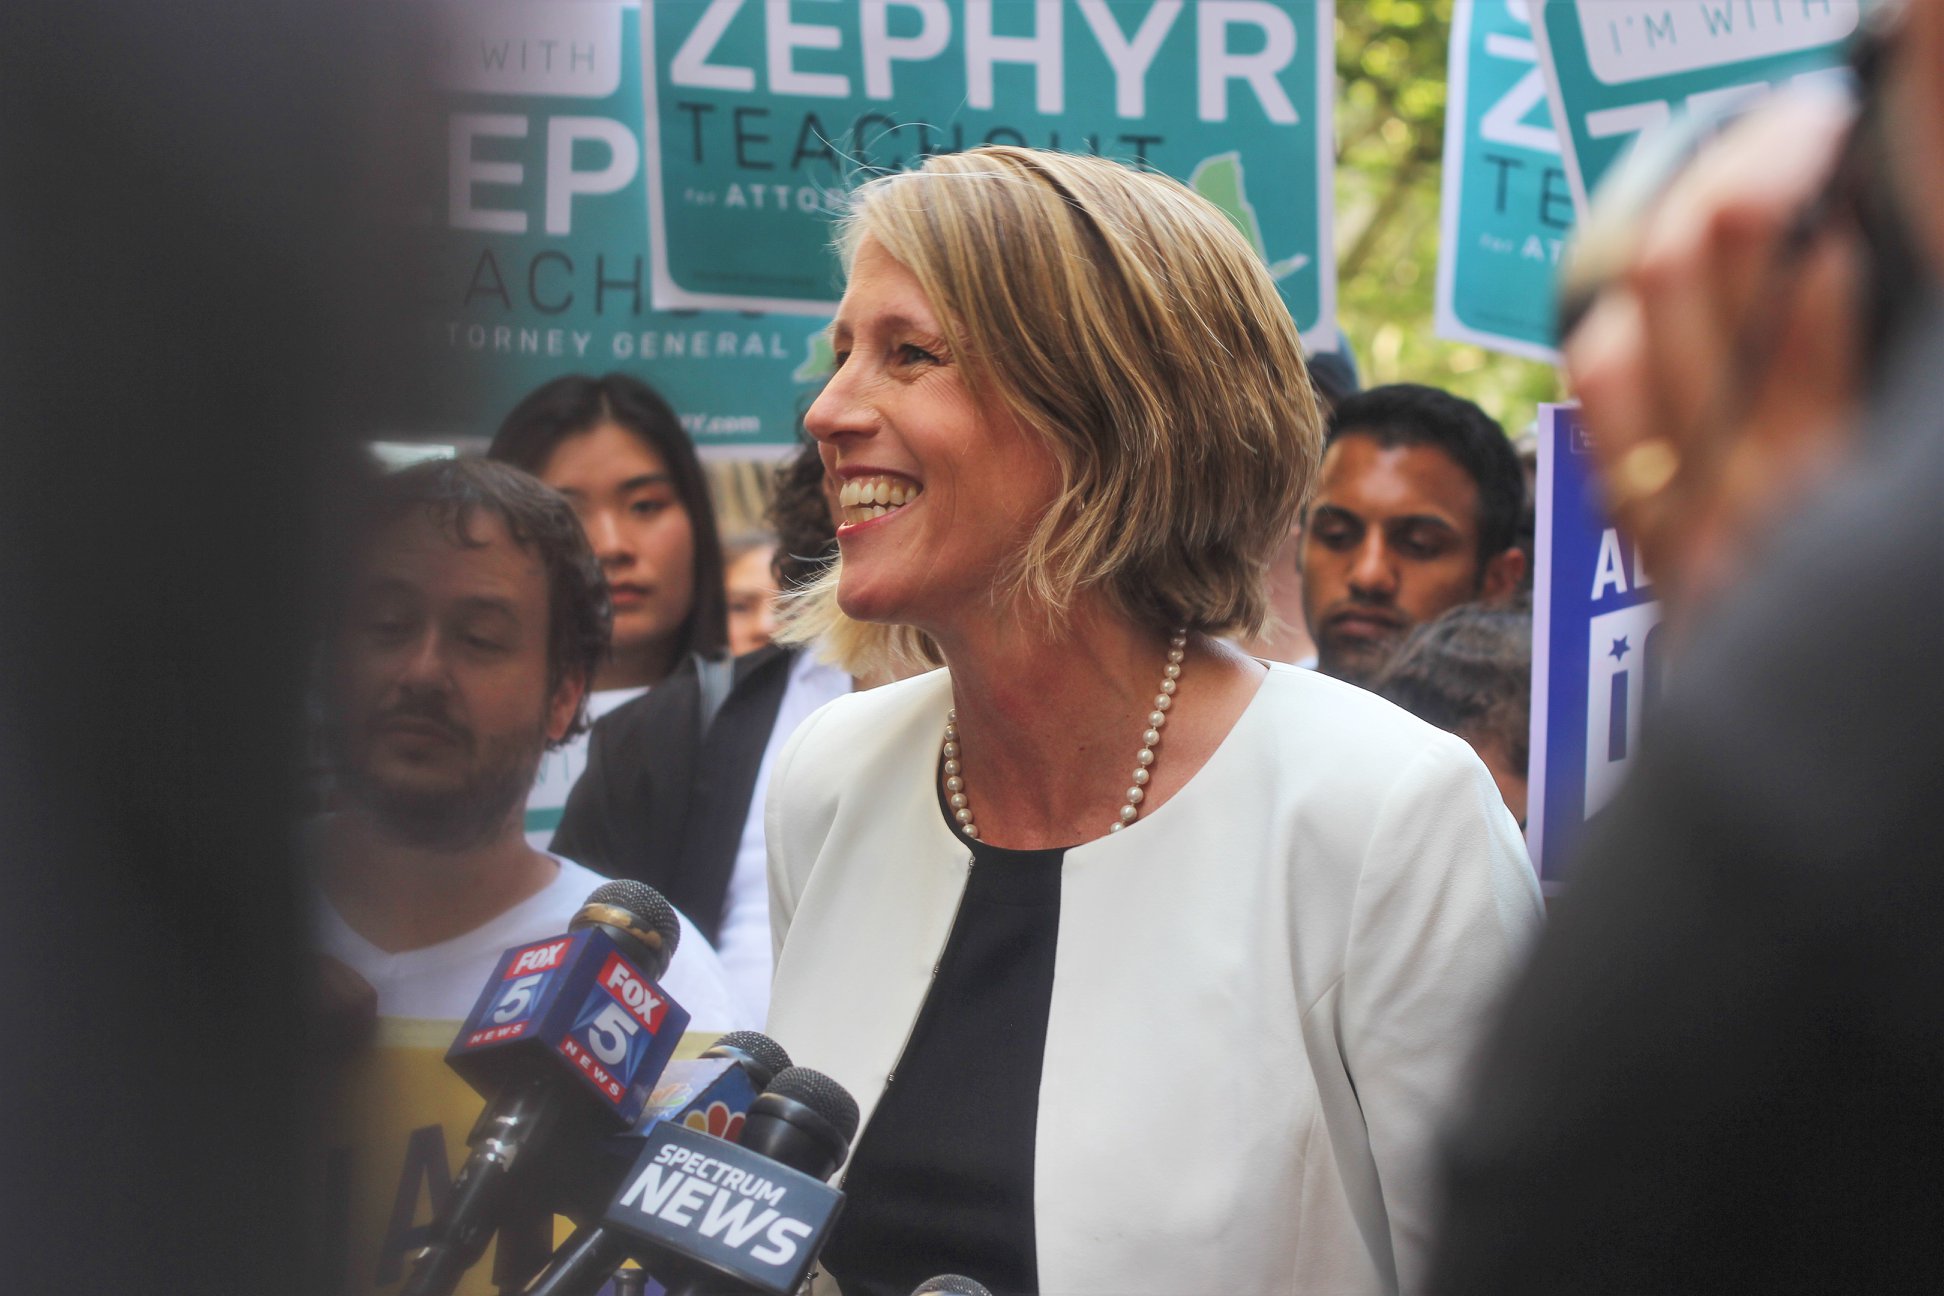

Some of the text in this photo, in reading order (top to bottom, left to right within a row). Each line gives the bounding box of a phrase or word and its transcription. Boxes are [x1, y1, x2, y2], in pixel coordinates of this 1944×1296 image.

[480, 40, 597, 74] WITH
[671, 0, 1299, 124] ZEPHYR
[1608, 10, 1678, 56] I'M
[448, 112, 641, 236] EP
[1482, 152, 1573, 231] TE
[1520, 233, 1563, 266] AT
[463, 248, 643, 317] ACH
[445, 322, 791, 360] TORNEY GENERAL
[1590, 527, 1657, 601] AL
[512, 942, 566, 975] FOX
[493, 972, 544, 1024] 5
[607, 962, 661, 1025] FOX
[470, 1023, 524, 1044] NEWS
[588, 1001, 640, 1066] 5
[564, 1040, 621, 1097] NEWS
[653, 1143, 788, 1208] SPECTRUM
[619, 1162, 824, 1266] NEWS
